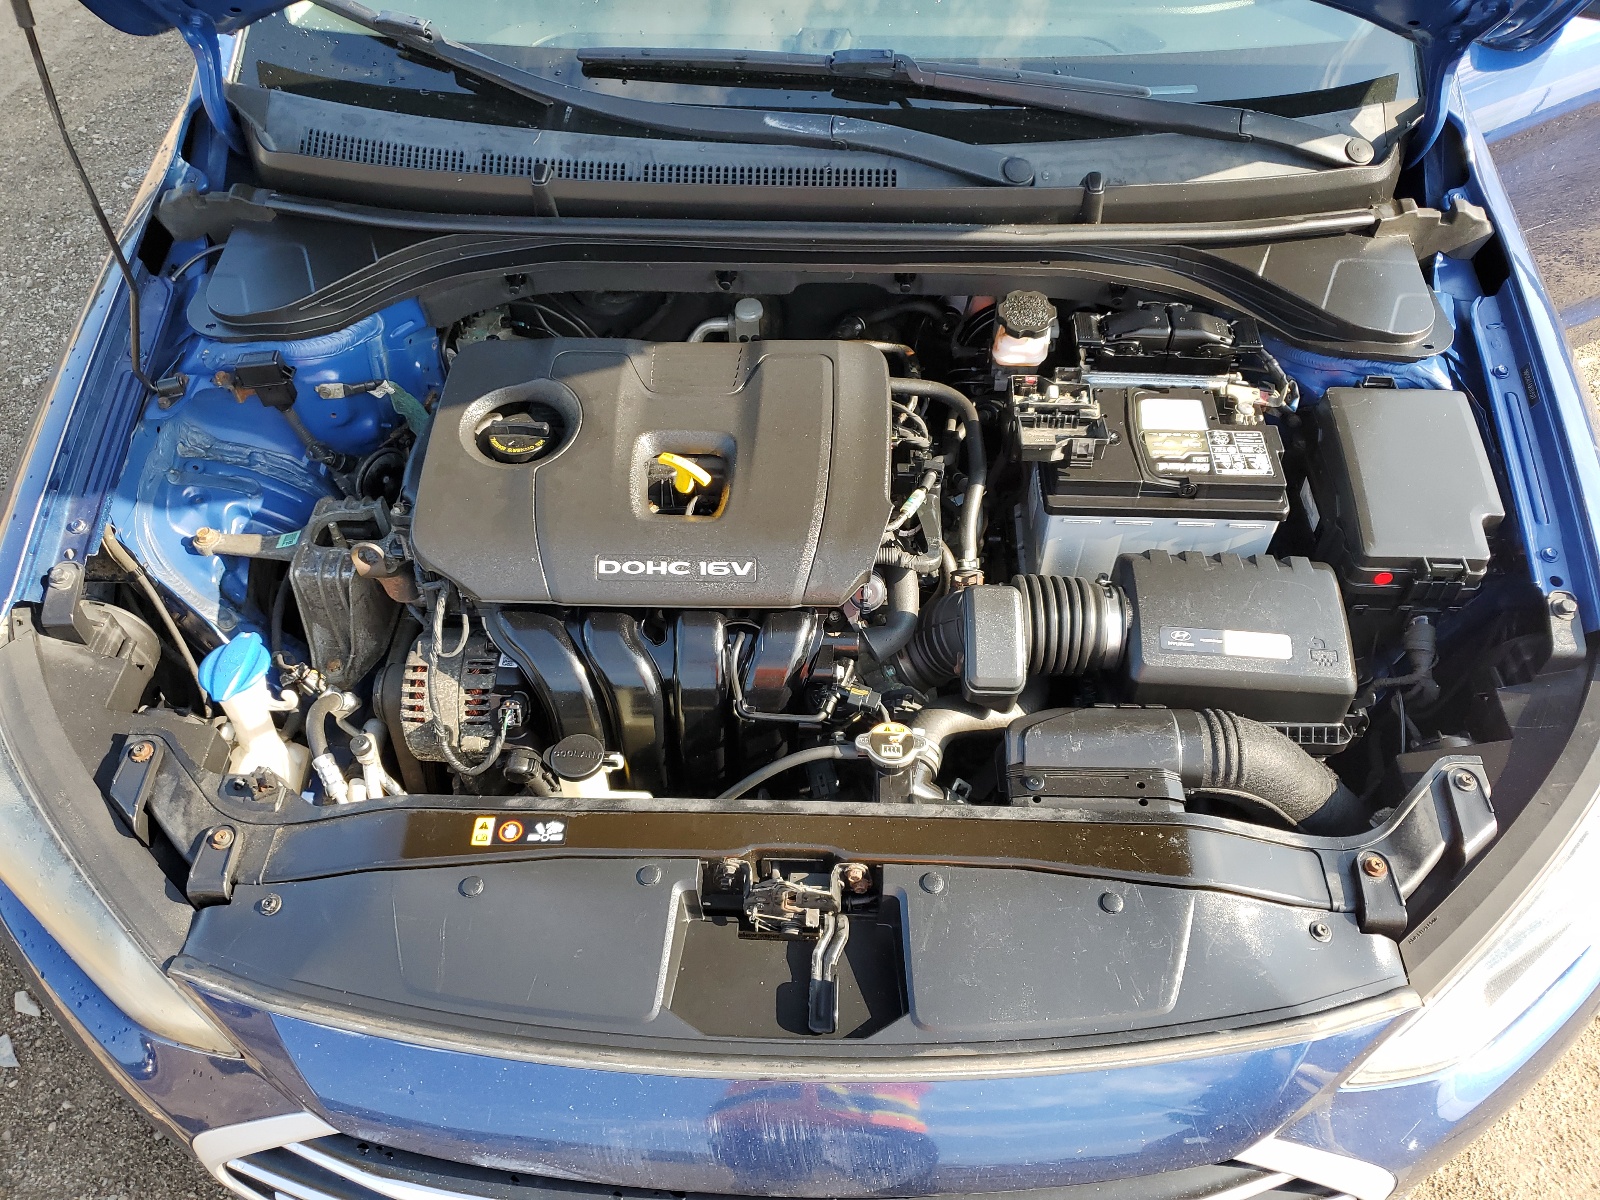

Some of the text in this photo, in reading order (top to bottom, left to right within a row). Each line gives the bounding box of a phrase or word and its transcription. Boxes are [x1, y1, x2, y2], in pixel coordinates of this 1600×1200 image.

[598, 560, 753, 577] DOHC 16V
[553, 750, 603, 760] COOLANT
